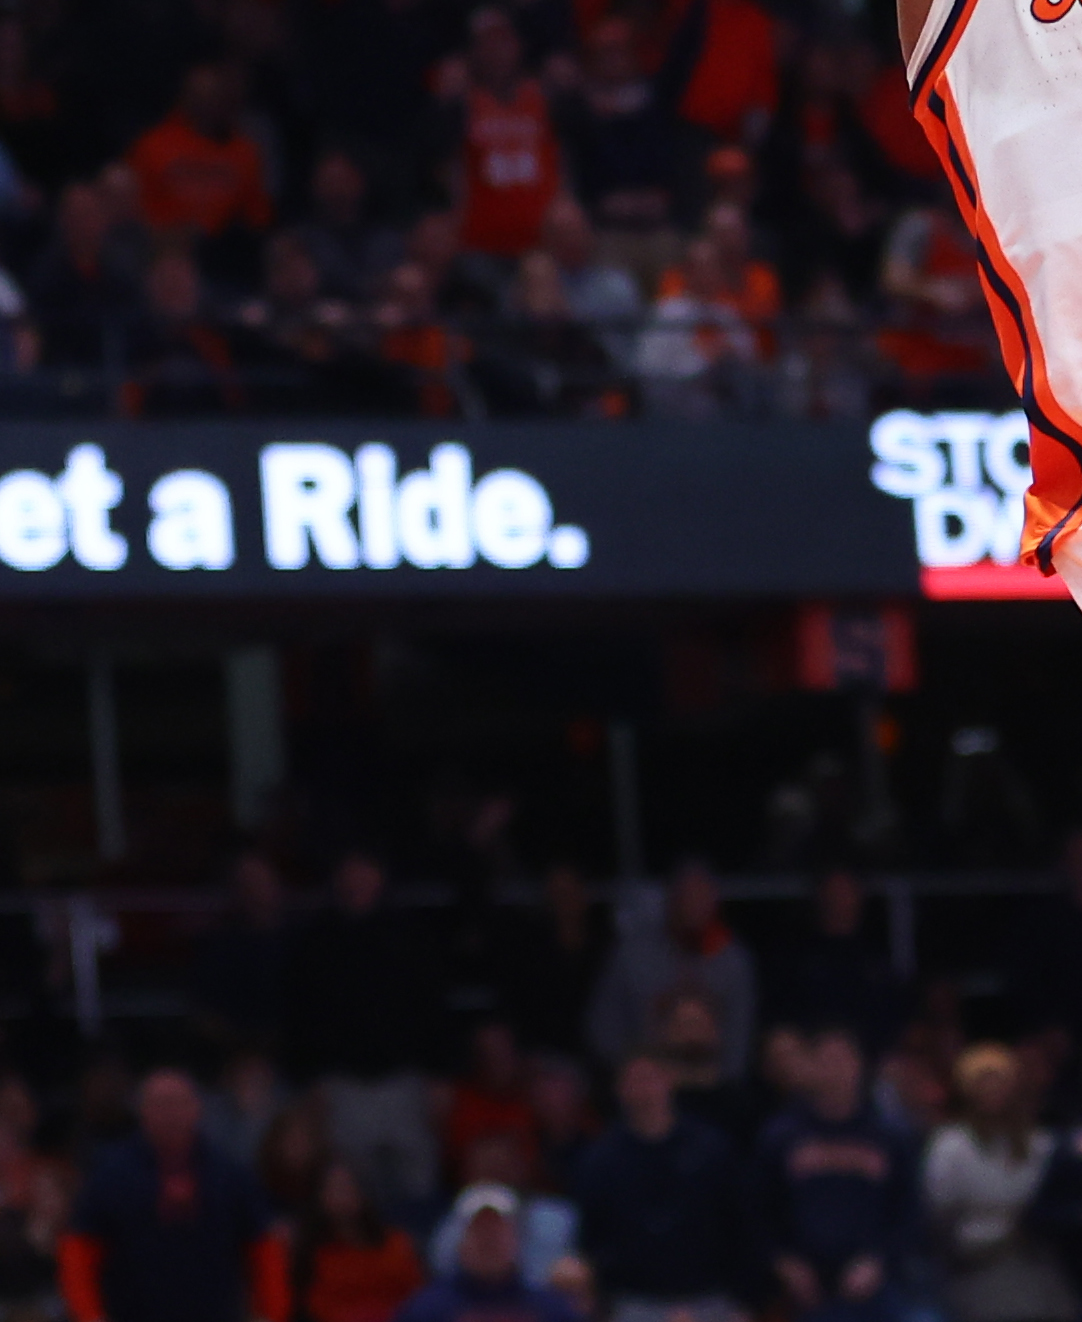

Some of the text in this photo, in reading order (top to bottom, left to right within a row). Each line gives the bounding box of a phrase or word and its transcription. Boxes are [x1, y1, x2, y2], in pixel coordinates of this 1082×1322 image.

[146, 468, 237, 571] a
[258, 441, 591, 571] Ride.
[868, 408, 1034, 499] STO
